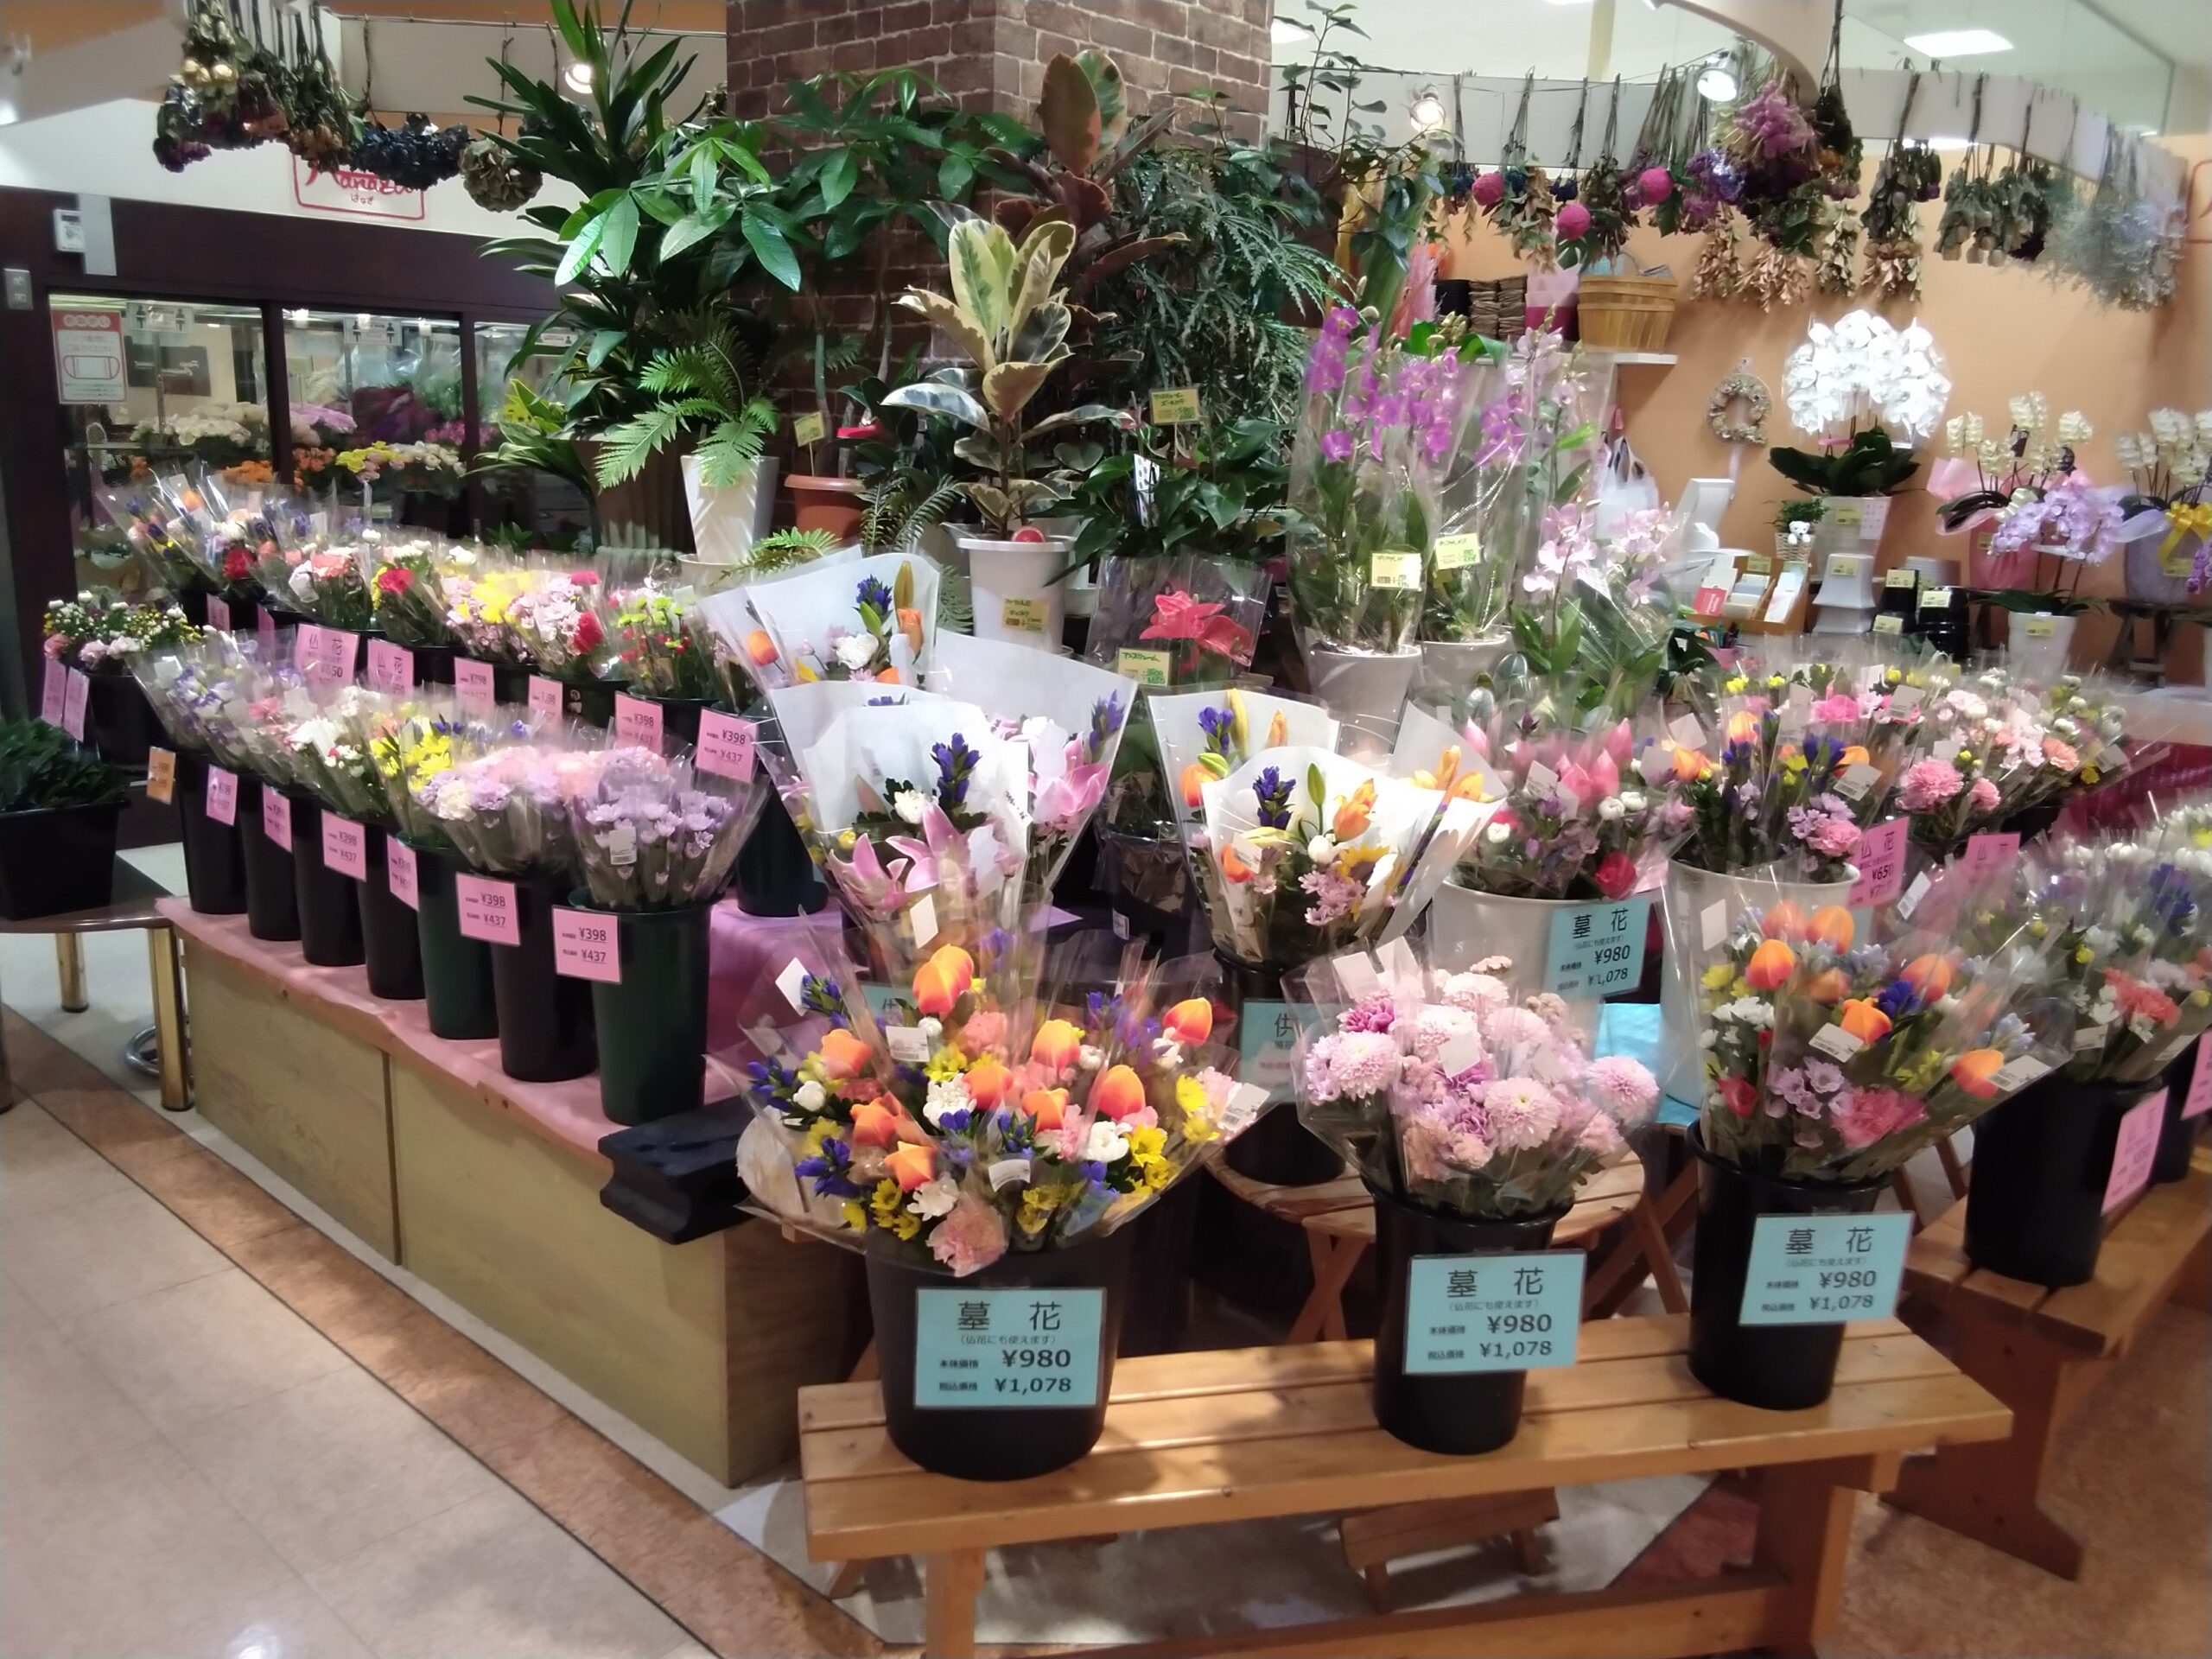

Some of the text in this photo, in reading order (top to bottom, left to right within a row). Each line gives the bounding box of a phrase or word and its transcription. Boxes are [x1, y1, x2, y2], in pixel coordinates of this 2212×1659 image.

[633, 713, 654, 728] ¥398
[721, 728, 746, 745] ¥398
[721, 749, 743, 762] ¥437
[480, 893, 506, 907] ¥398
[484, 913, 506, 926] ¥437
[579, 927, 607, 941] ¥398
[582, 949, 607, 963] ¥437
[1594, 944, 1630, 964] ¥980
[1819, 1270, 1877, 1288] ¥980
[1809, 1294, 1874, 1313] ¥1,078
[1487, 1313, 1553, 1333] ¥980
[1002, 1350, 1071, 1368] ¥980
[1479, 1341, 1553, 1360] ¥1,078
[995, 1377, 1071, 1395] ¥1,078
